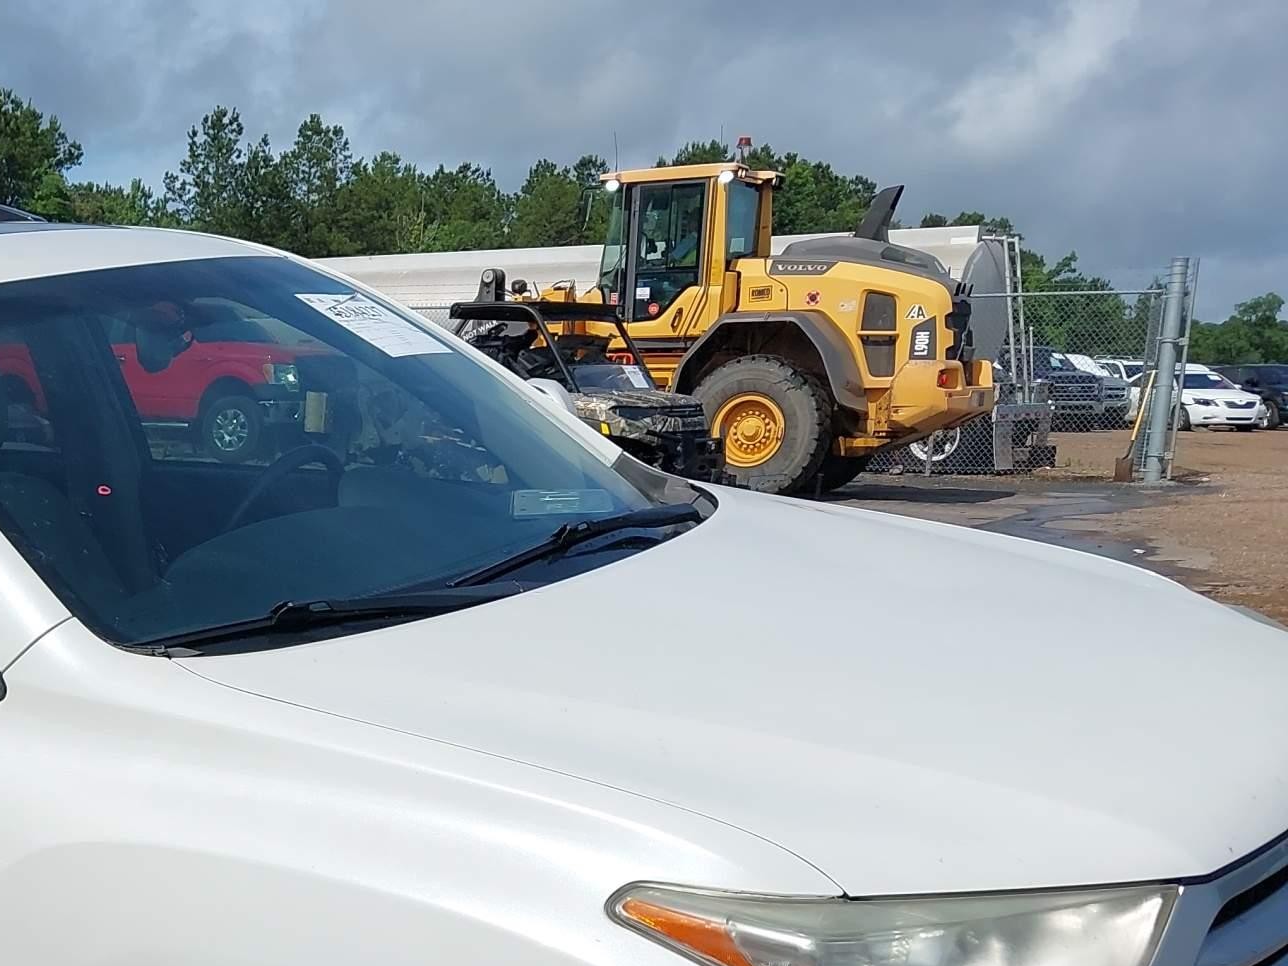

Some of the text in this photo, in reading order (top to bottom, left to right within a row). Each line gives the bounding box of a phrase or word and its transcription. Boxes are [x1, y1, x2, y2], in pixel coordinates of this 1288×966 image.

[776, 263, 827, 272] VOLVO
[462, 328, 477, 341] NOT
[913, 331, 931, 356] L90H
